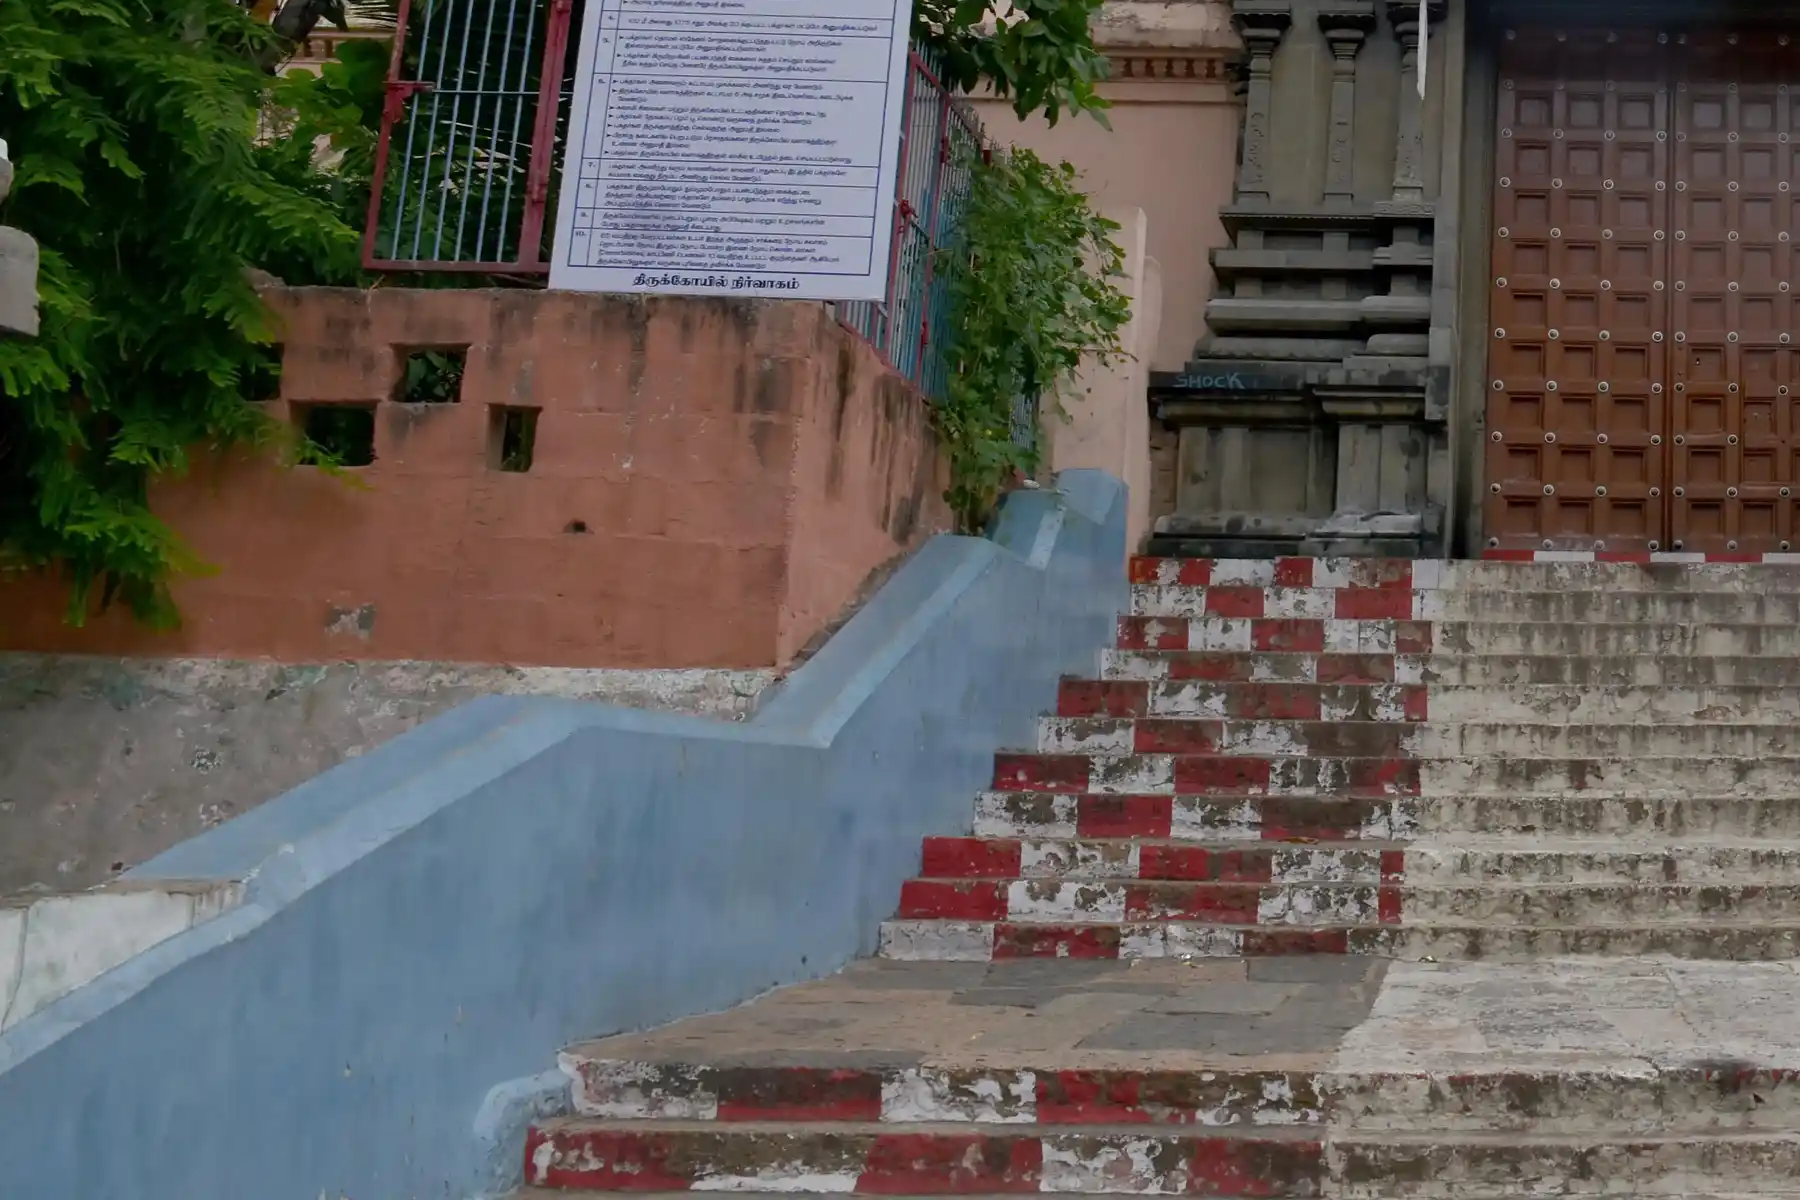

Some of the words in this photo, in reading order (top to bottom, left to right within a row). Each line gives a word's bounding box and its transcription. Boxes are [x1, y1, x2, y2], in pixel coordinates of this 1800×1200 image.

[632, 272, 728, 287] திருக்கோயில்
[730, 275, 799, 289] நிர்வாகம்
[1171, 371, 1246, 389] SHOCK
